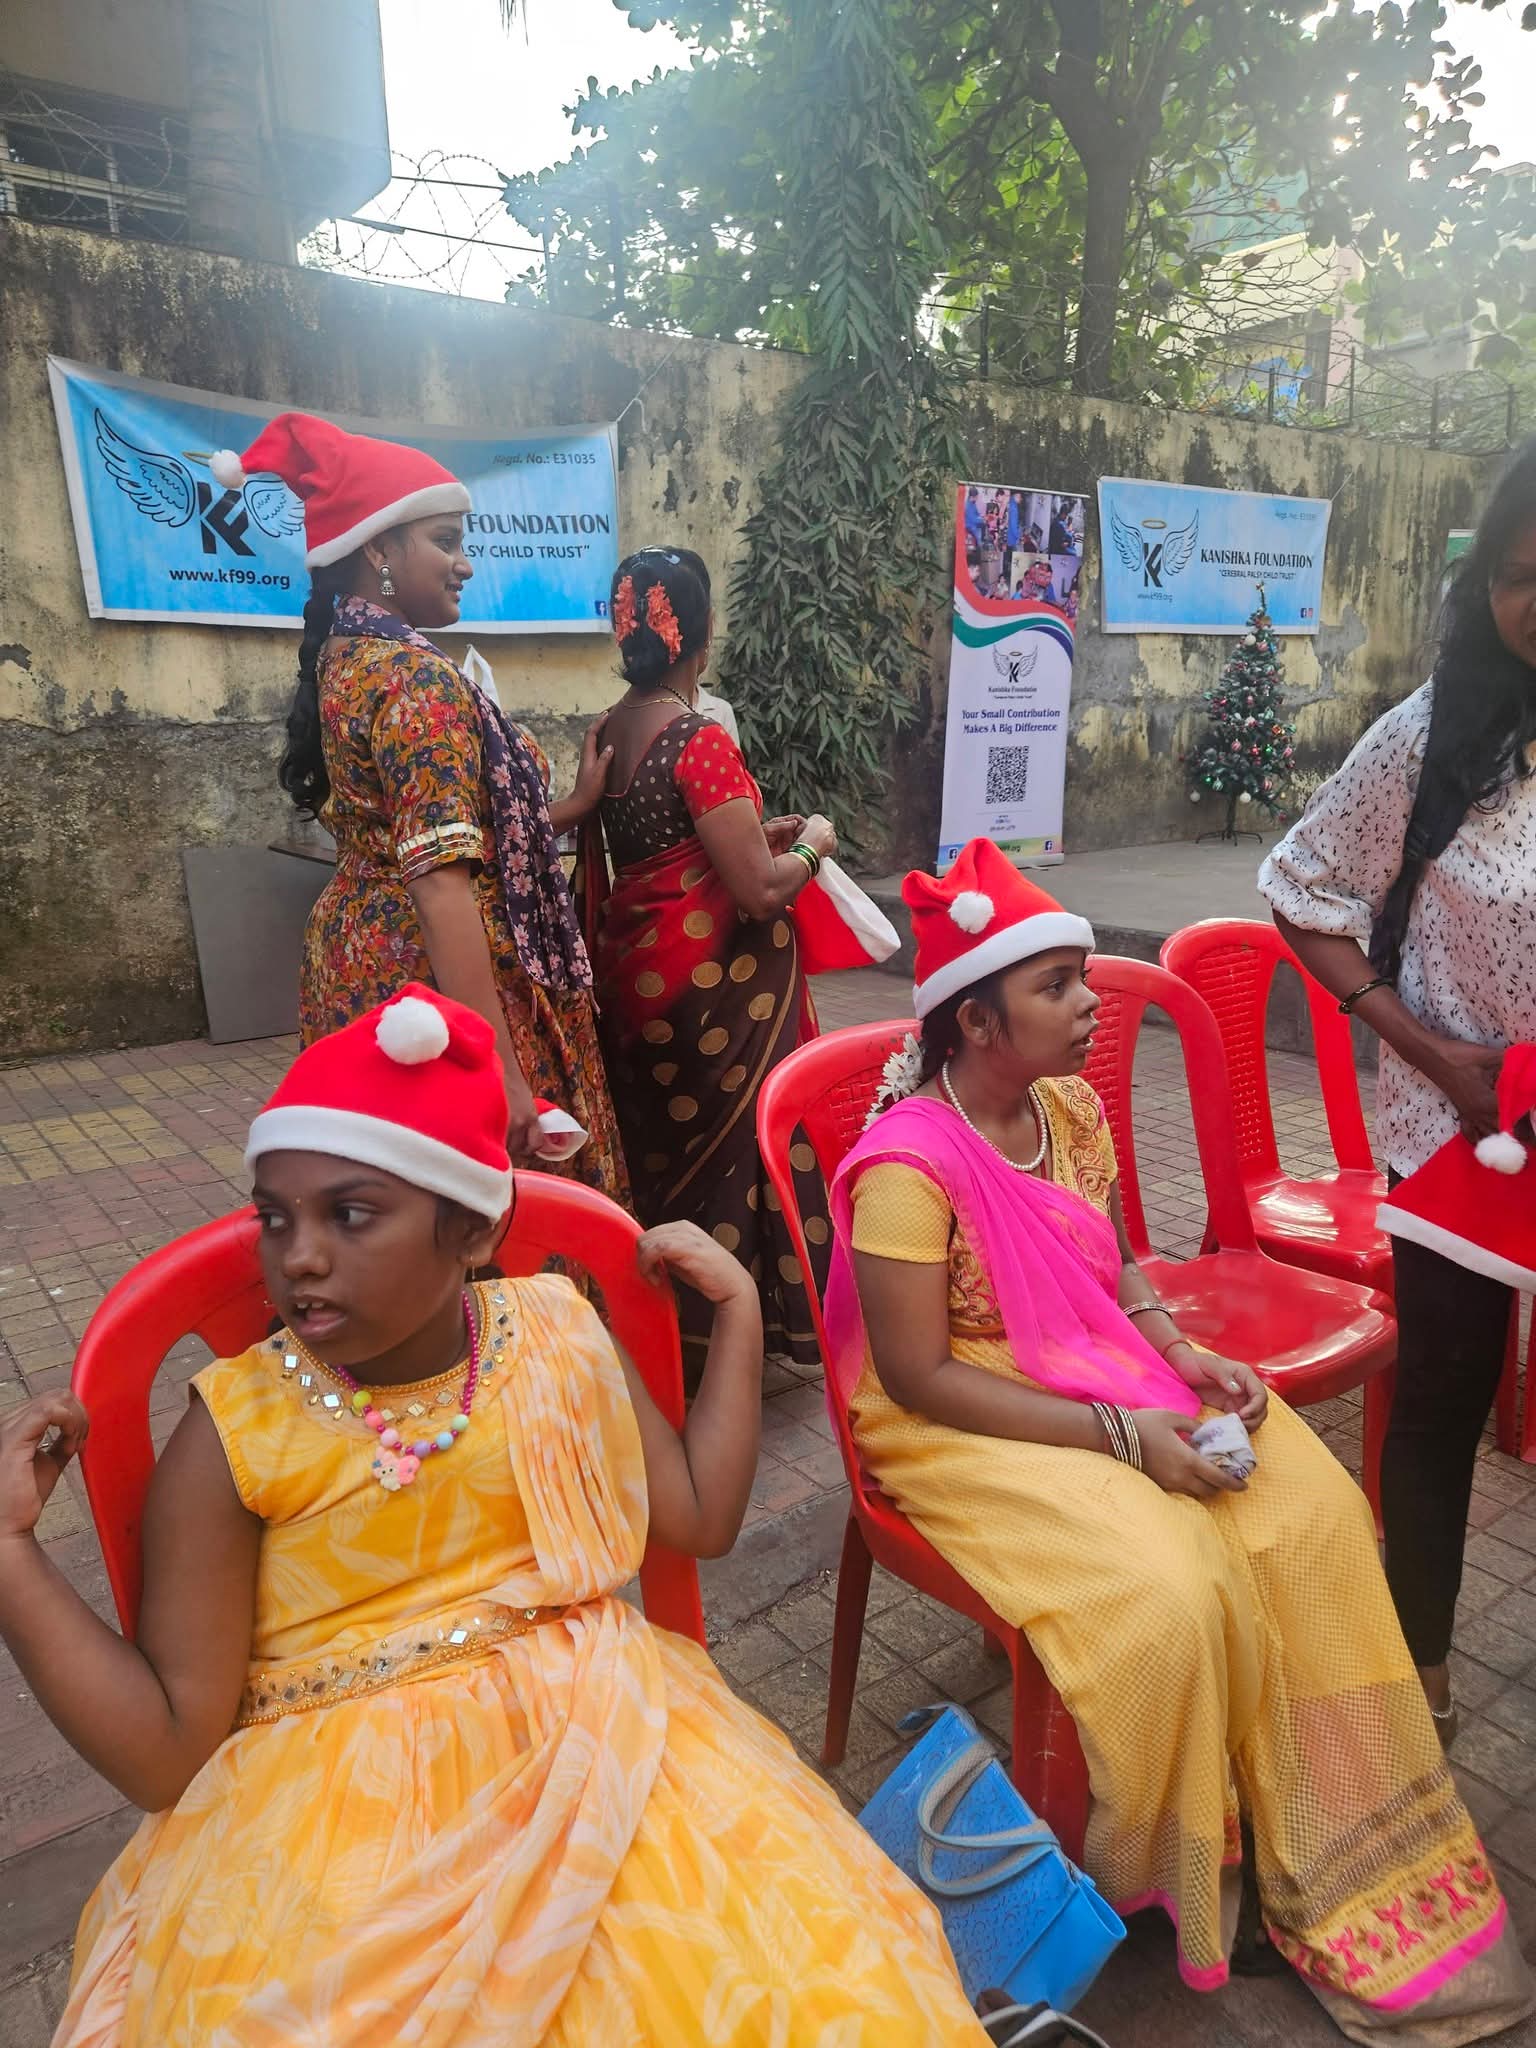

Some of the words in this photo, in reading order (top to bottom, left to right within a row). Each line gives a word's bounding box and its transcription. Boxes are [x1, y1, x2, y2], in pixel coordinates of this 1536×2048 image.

[552, 453, 597, 465] E31035
[466, 513, 611, 535] FOUNDATION
[489, 545, 534, 559] CHILD
[1200, 548, 1252, 566] KANISHKA
[1254, 551, 1313, 569] FOUNDATION
[168, 568, 291, 591] www.kf99.org
[962, 709, 979, 719] Your
[981, 708, 1005, 719] Small
[1007, 707, 1061, 719] Contribution
[963, 724, 989, 735] Makes
[990, 723, 997, 733] A
[999, 723, 1013, 735] Big
[1015, 722, 1058, 733] Difference
